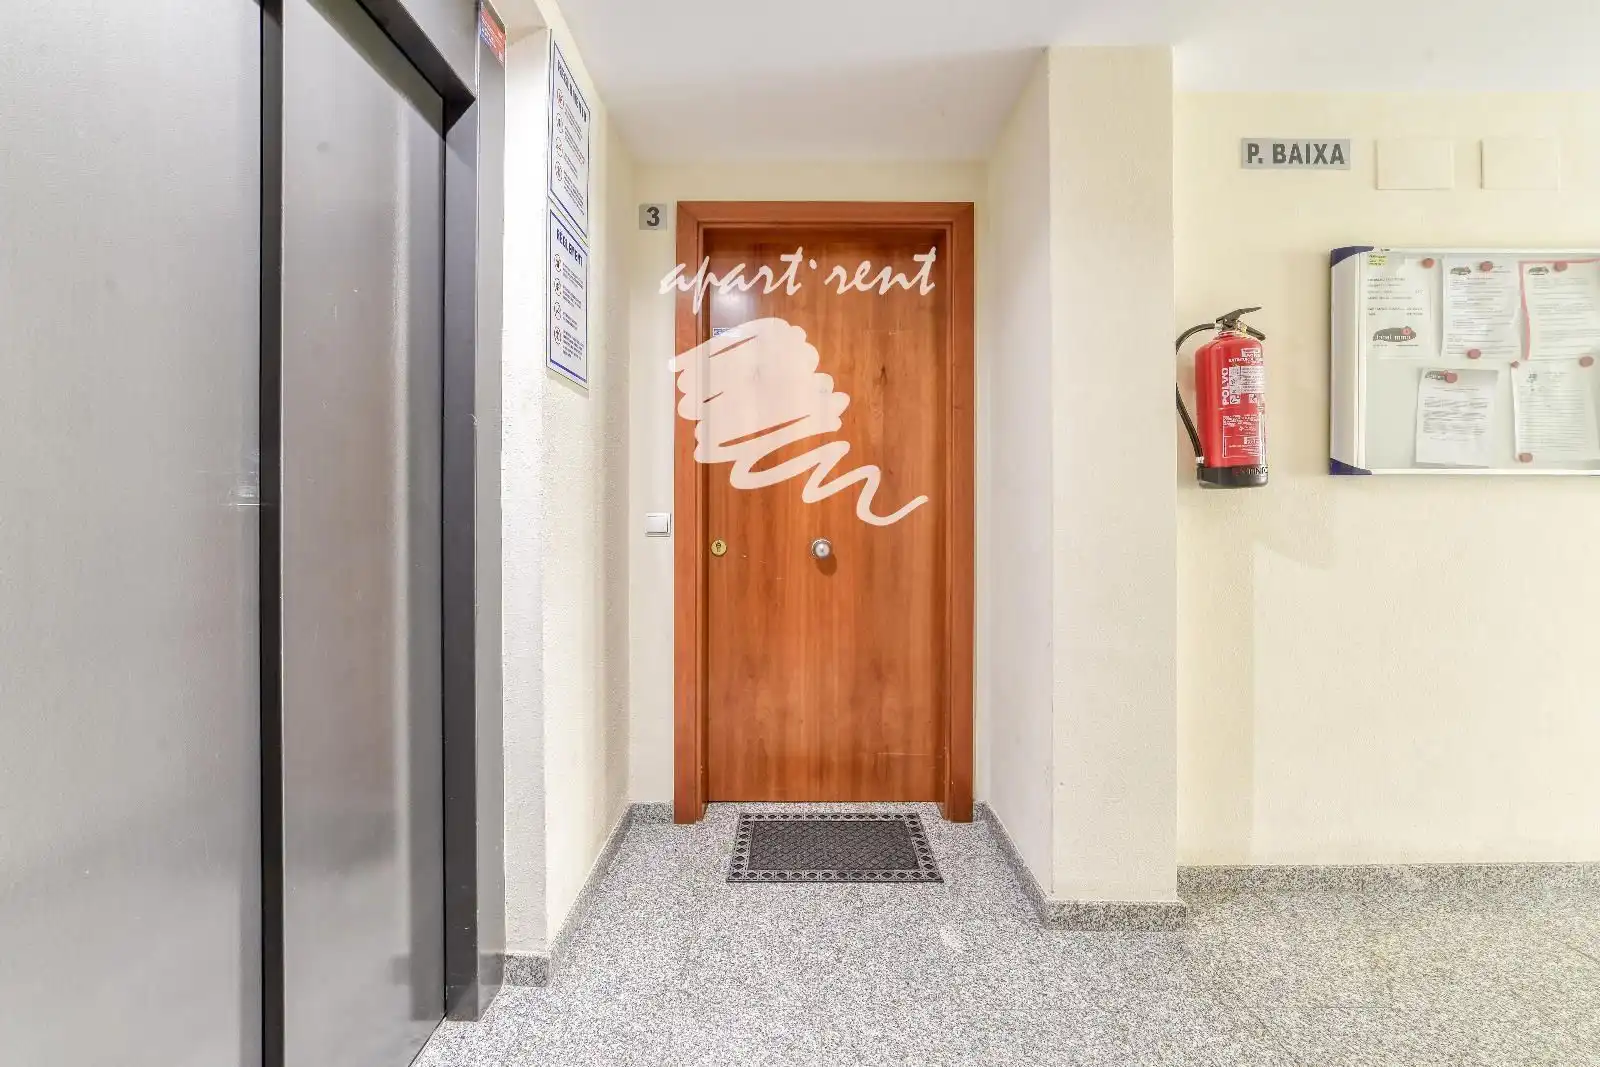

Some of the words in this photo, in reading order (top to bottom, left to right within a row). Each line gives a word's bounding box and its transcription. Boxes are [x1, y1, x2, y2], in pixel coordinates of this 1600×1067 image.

[1247, 143, 1264, 164] P.
[1272, 143, 1345, 165] BAIXA
[646, 206, 660, 227] 3
[1221, 367, 1230, 406] POLVO
